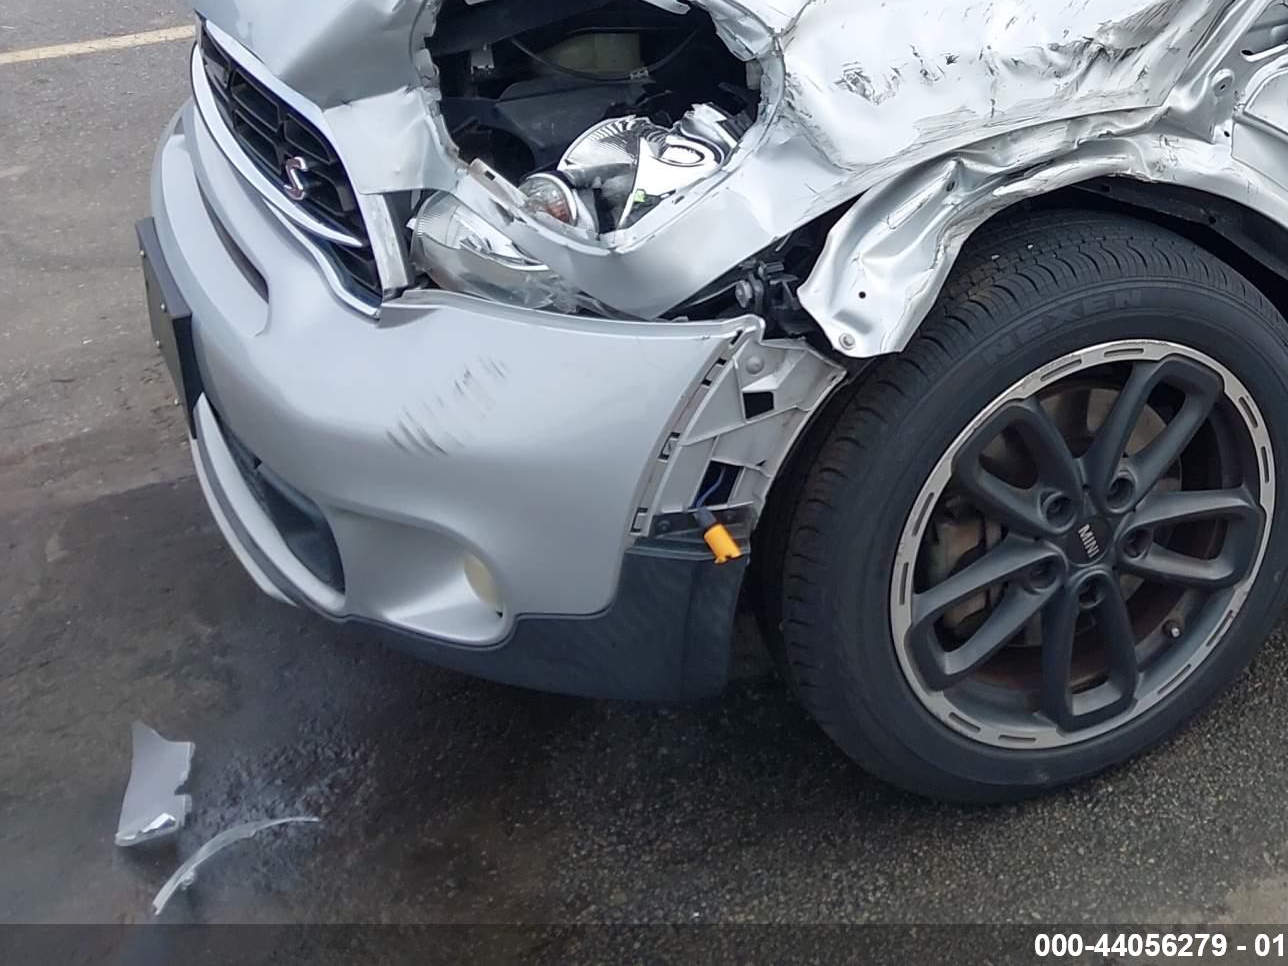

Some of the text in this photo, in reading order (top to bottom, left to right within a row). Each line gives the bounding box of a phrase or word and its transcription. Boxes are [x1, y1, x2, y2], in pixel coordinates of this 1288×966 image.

[283, 156, 308, 201] S
[982, 288, 1143, 366] NEXEN
[1077, 523, 1101, 559] MINI
